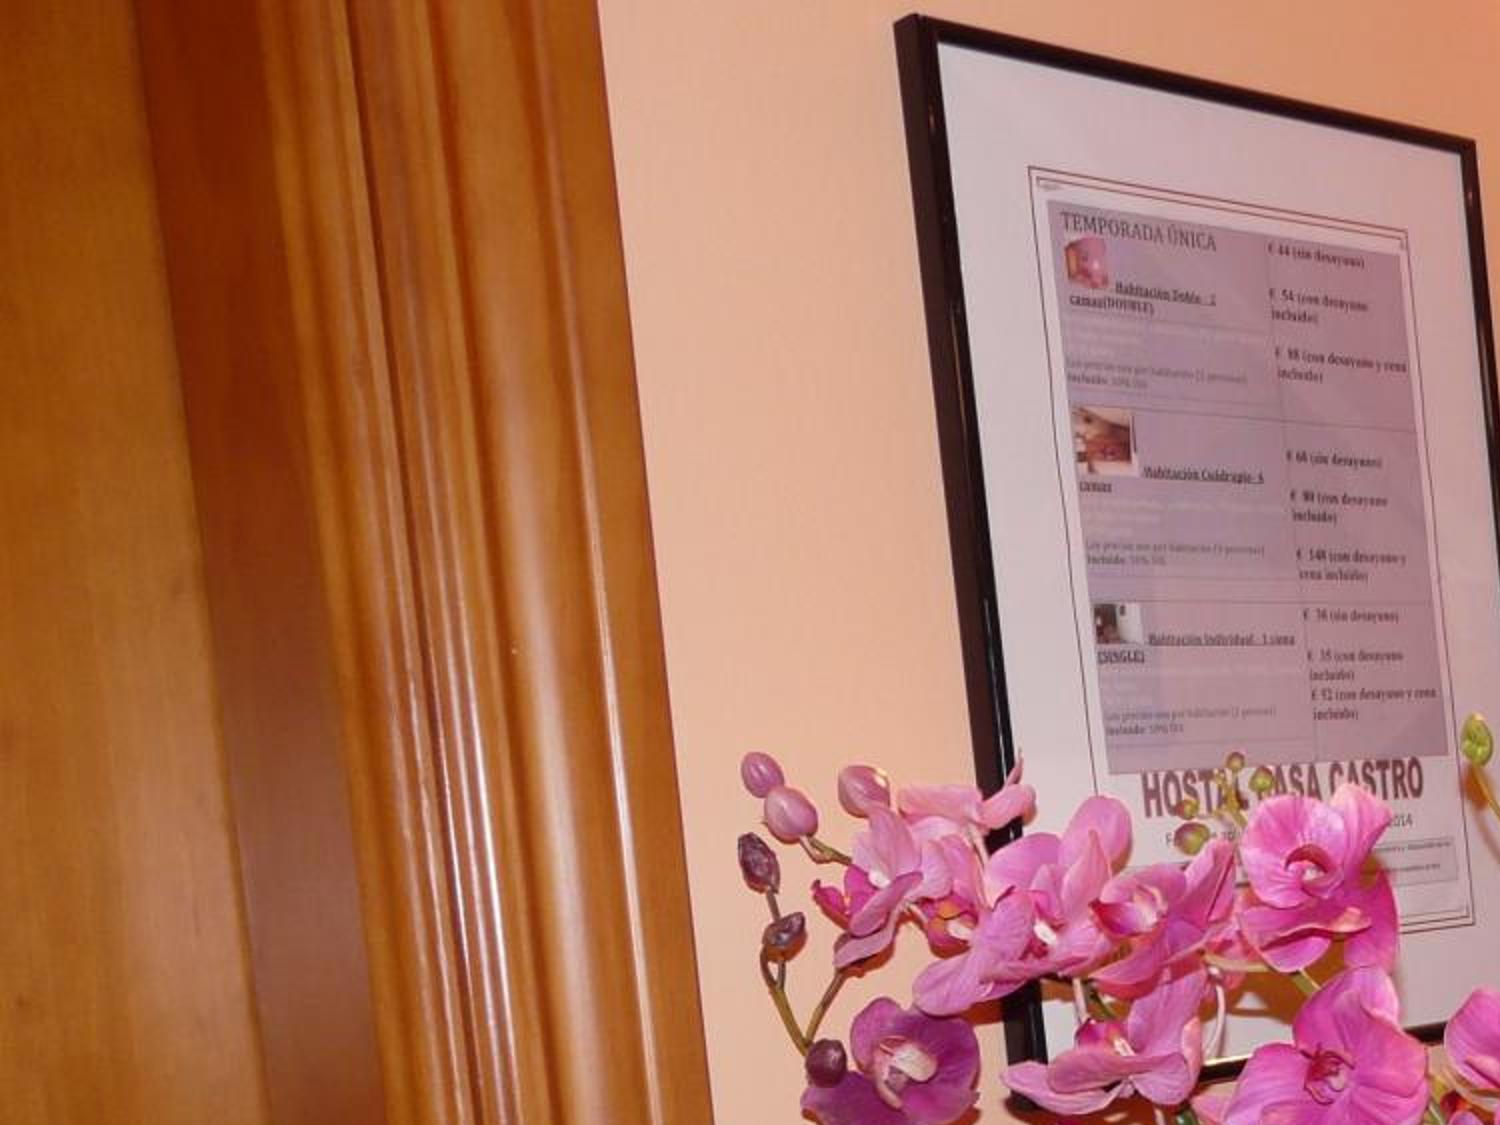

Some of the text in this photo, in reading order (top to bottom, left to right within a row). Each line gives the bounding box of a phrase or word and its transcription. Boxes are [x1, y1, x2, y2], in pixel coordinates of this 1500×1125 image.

[1061, 212, 1217, 252] TEMPORADA ÚNICA
[1115, 281, 1171, 301] Habitación
[1143, 466, 1199, 481] Habitación
